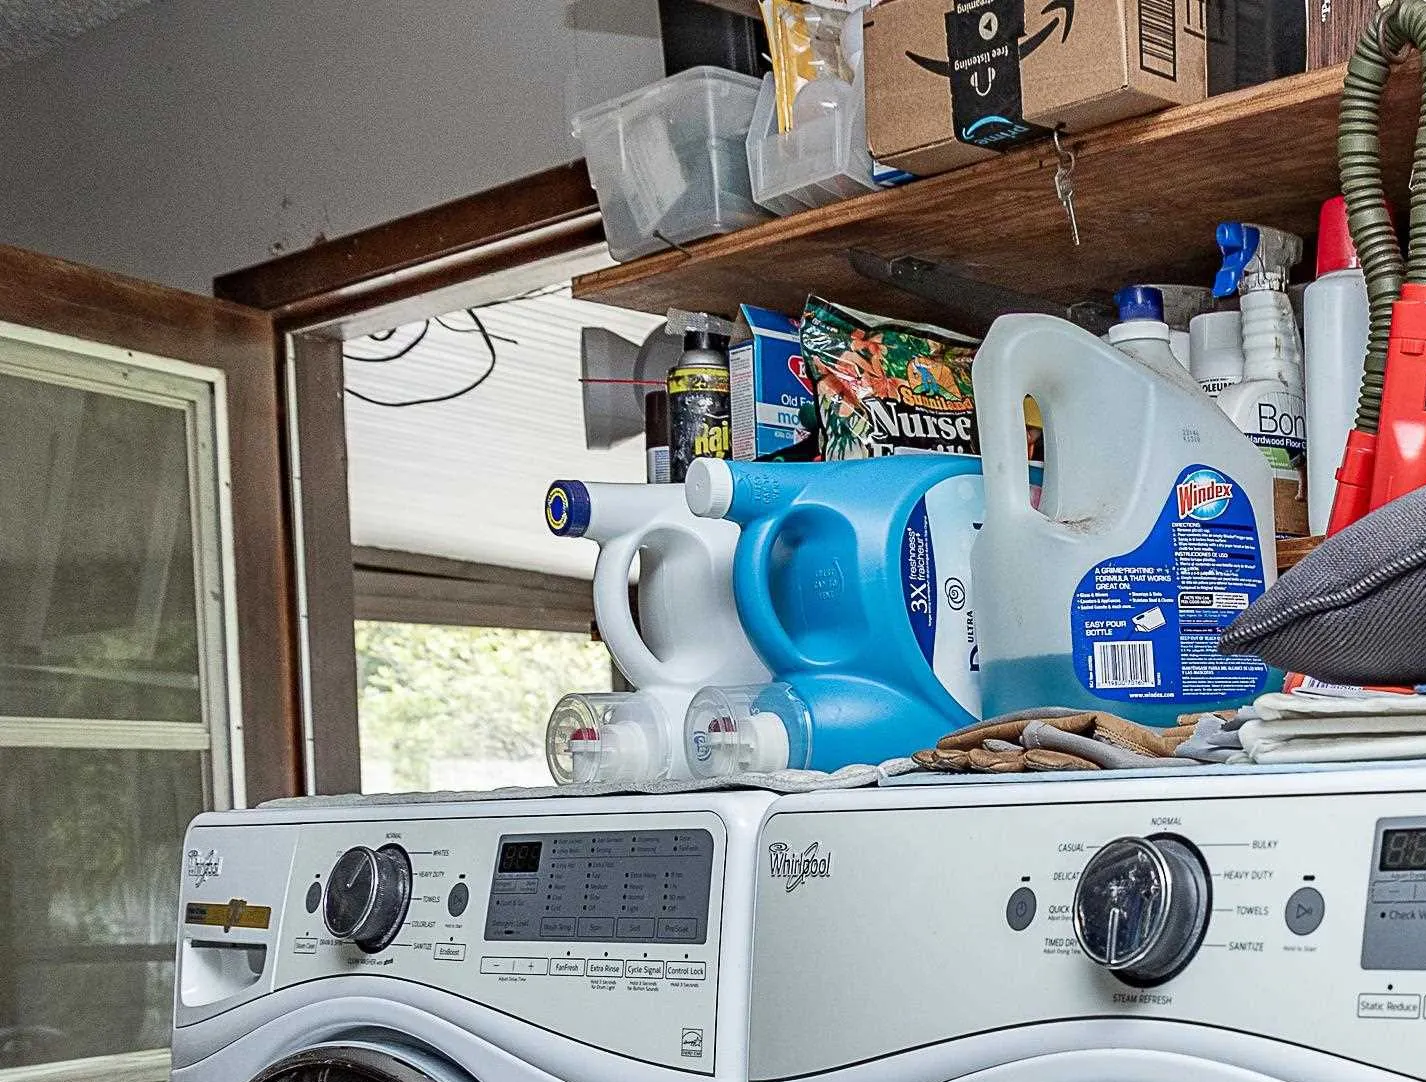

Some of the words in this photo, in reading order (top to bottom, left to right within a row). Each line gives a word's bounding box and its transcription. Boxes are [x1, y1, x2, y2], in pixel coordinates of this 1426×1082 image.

[992, 45, 1009, 58] free
[954, 51, 990, 71] listening
[974, 124, 1030, 145] prime
[1202, 382, 1235, 393] OLEU
[781, 394, 798, 407] Old
[862, 397, 971, 441] Nurse
[695, 420, 729, 456] Rai
[1285, 438, 1301, 448] Floor
[1177, 482, 1233, 519] Windex
[910, 583, 928, 614] 3X
[1106, 620, 1126, 628] POUR
[1151, 817, 1182, 826] NORMAL
[1058, 843, 1084, 852] CASUAL
[1252, 840, 1279, 849] BULKY
[769, 847, 831, 886] Whirlpool
[1053, 872, 1080, 881] DELICAT
[1224, 871, 1249, 880] HEAVY
[1251, 870, 1273, 879] DUTY
[1049, 905, 1070, 914] QUICK
[1236, 906, 1269, 915] TOWELS
[1389, 911, 1416, 920] Check
[1045, 937, 1063, 947] TIMED
[1228, 942, 1264, 952] SANITIZE
[556, 963, 579, 971] FanFresh
[590, 964, 603, 973] Extra
[604, 964, 620, 973] Rinse
[627, 965, 643, 975] Cycle
[644, 965, 661, 975] Signal
[667, 966, 689, 975] Control
[690, 967, 704, 975] Lock
[1112, 993, 1138, 1004] STEAM
[1138, 994, 1172, 1005] REFRESH
[1361, 1001, 1383, 1010] Static
[1387, 1002, 1418, 1011] Reduce
